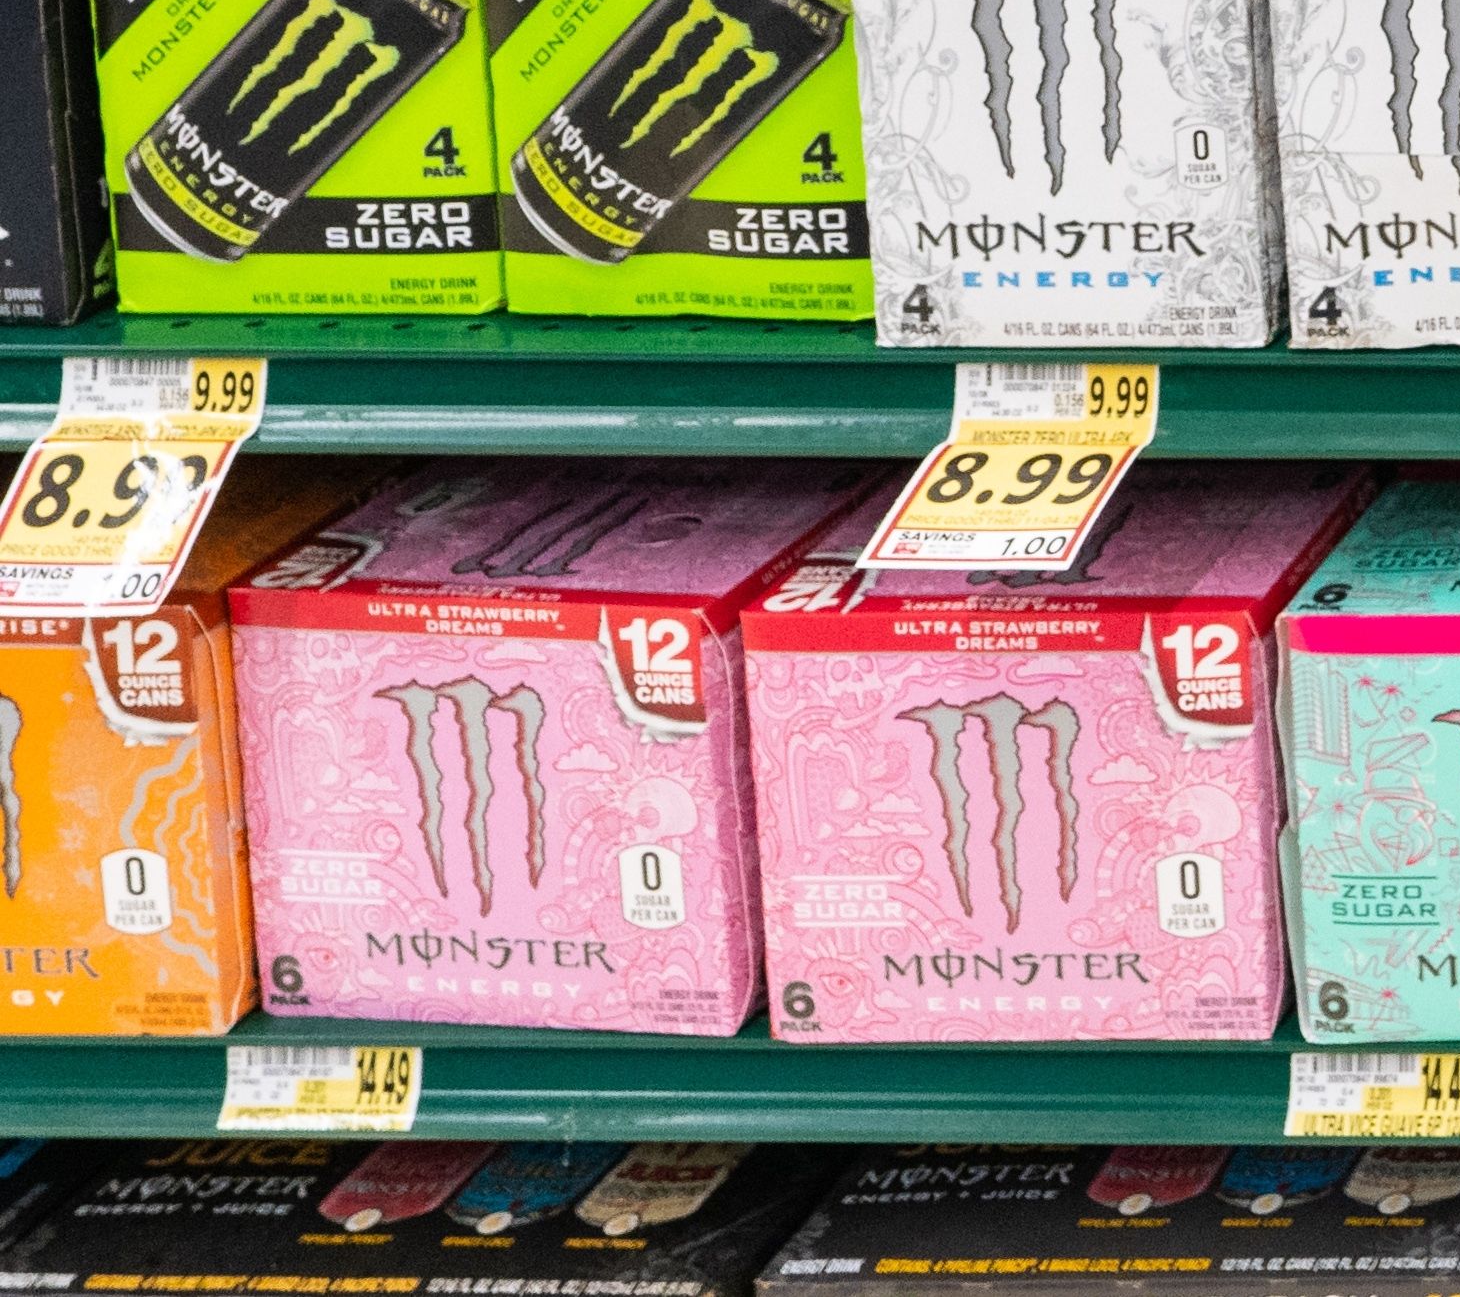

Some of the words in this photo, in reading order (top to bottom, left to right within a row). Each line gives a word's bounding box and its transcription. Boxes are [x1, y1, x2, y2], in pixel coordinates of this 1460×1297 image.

[423, 126, 461, 165] 4
[356, 202, 470, 225] ZERO
[325, 225, 473, 250] SUGAR
[916, 215, 1206, 261] MONSTER
[962, 272, 1164, 289] ENERGY
[195, 372, 255, 413] 9.99
[927, 452, 1114, 504] 8.99
[368, 605, 430, 617] ULTRA
[437, 604, 561, 623] STRAWBERRY
[426, 620, 503, 635] DREAMS
[630, 622, 693, 673] 12
[636, 674, 695, 690] OUNCE
[635, 688, 695, 707] CANS
[367, 931, 617, 973] MONSTER
